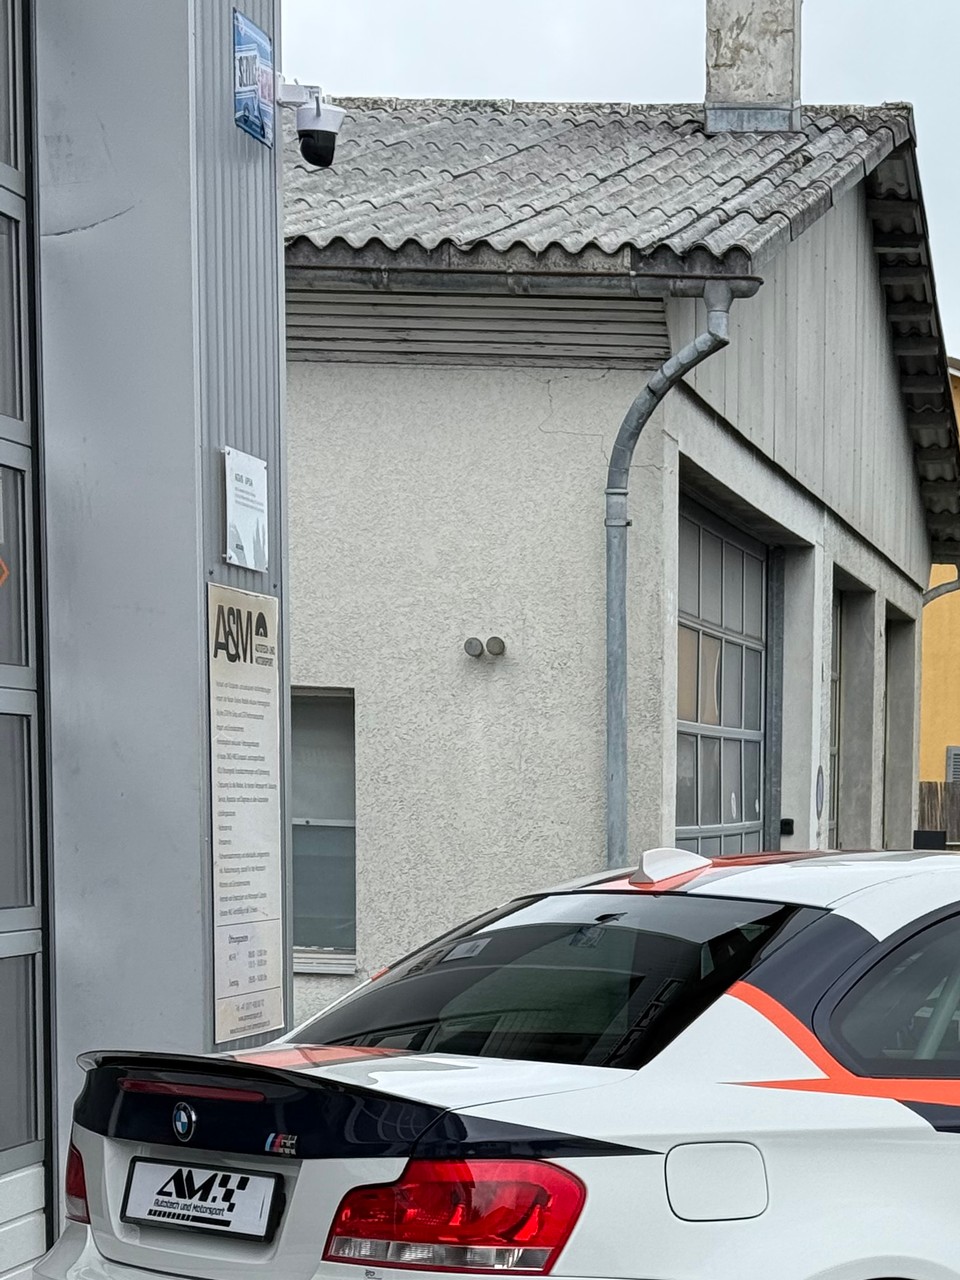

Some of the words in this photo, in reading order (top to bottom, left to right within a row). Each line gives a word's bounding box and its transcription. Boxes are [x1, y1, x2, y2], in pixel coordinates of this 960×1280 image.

[154, 1199, 180, 1210] Autotech
[180, 1203, 192, 1212] und
[192, 1203, 225, 1216] Motorsport
